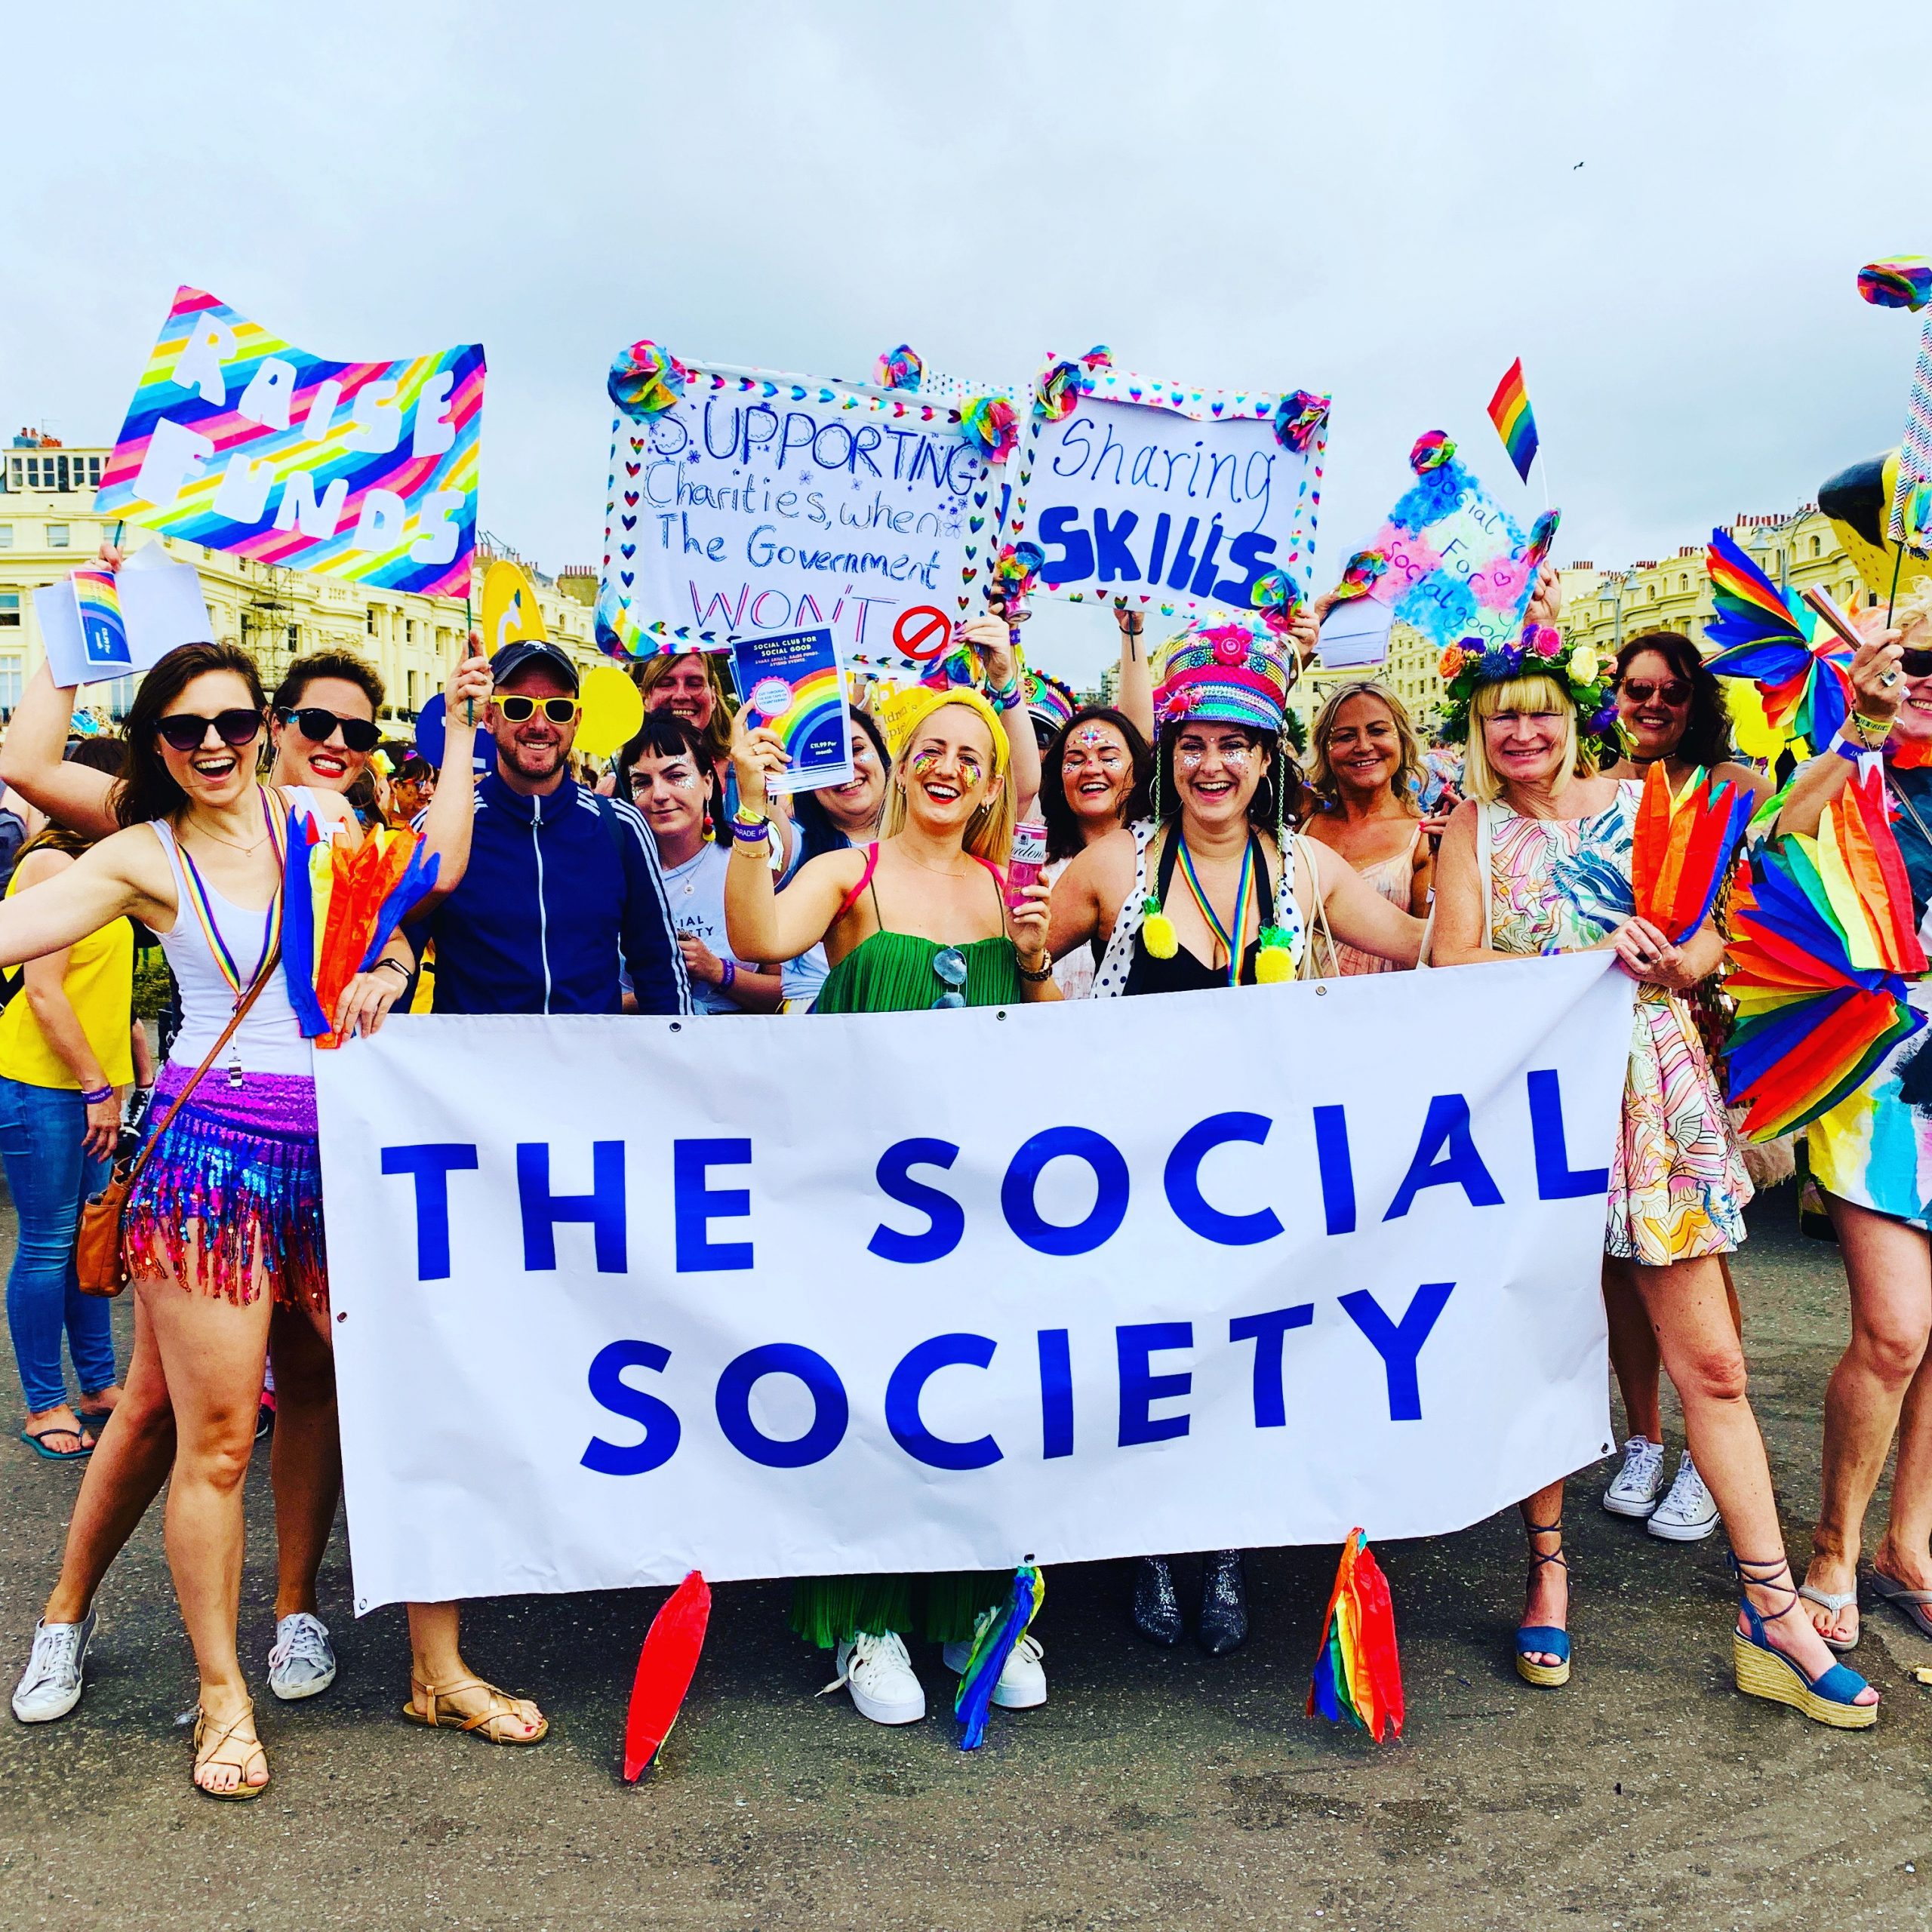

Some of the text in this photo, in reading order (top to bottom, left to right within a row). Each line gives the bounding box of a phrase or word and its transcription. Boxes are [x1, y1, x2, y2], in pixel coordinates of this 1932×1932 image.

[172, 311, 456, 458] RAISE
[653, 401, 978, 495] SUPPORTING
[1054, 418, 1275, 540] Sharing
[132, 417, 466, 565] FUNDS
[839, 491, 942, 538] when
[1426, 465, 1499, 536] Social
[656, 511, 941, 590] The Government
[1386, 541, 1454, 609] Social
[1439, 537, 1484, 586] For
[753, 641, 780, 651] SOCIAL
[761, 644, 811, 657] SOCIAL GOOD
[734, 826, 756, 837] PARADE
[380, 1069, 1611, 1281] THE SOCIAL
[580, 1281, 1457, 1477] SOCIETY
